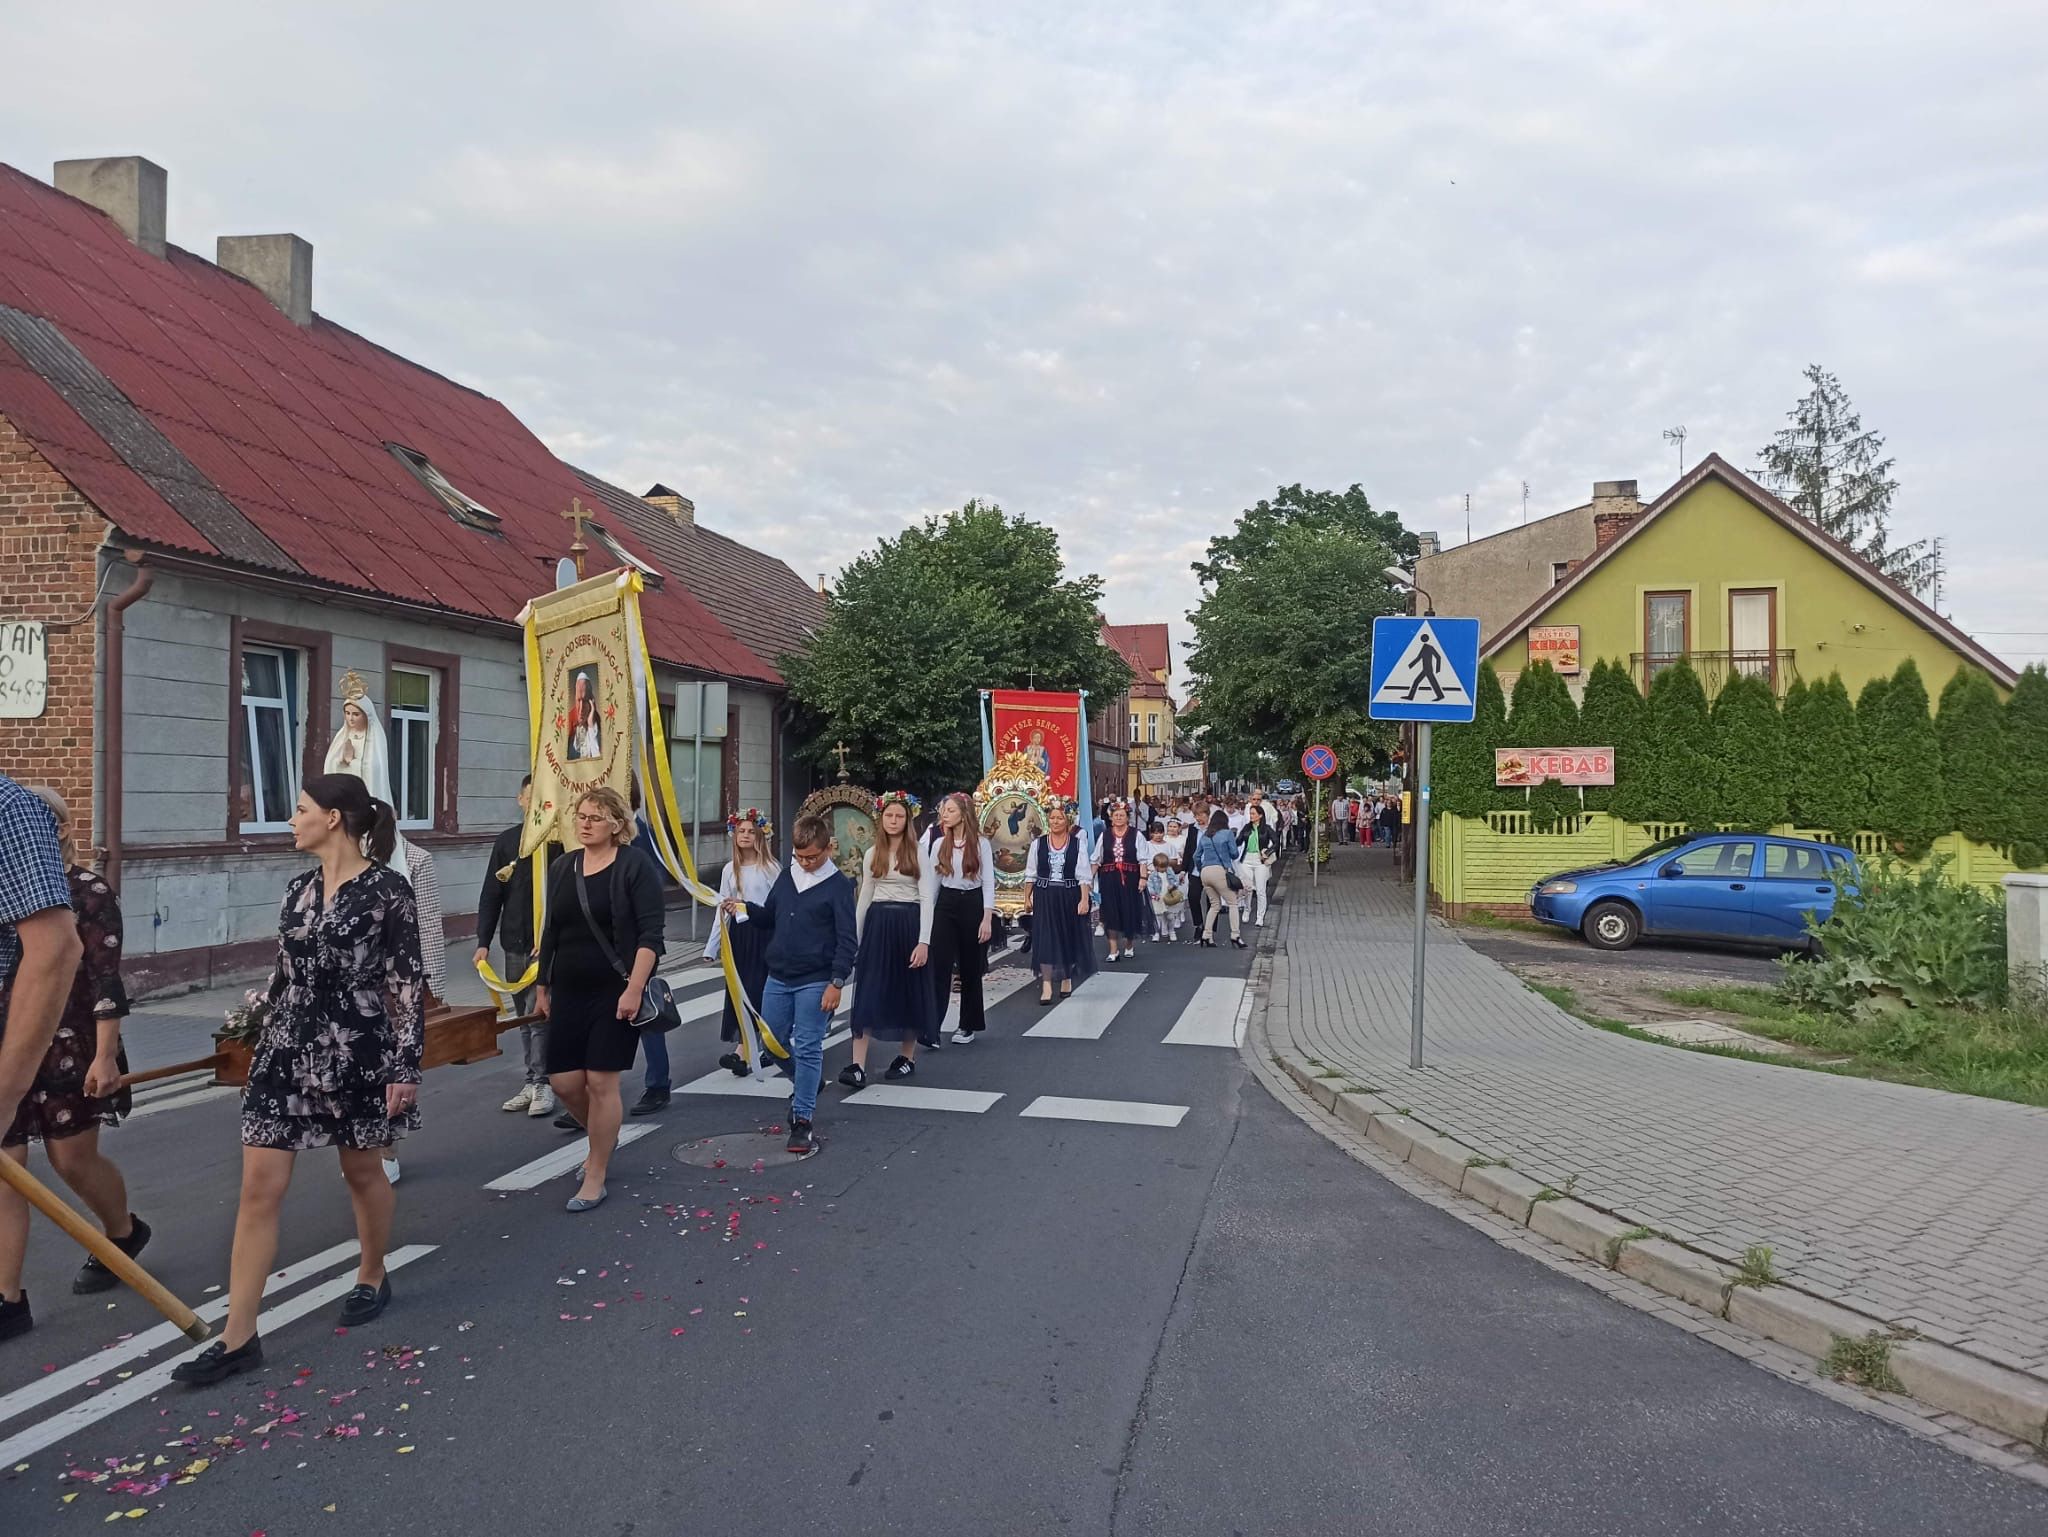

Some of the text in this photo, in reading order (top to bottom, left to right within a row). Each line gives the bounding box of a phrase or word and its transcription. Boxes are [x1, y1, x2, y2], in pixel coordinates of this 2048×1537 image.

[565, 640, 575, 658] OD
[574, 634, 592, 649] SIEBIE
[591, 635, 624, 683] WYMAGAĆ
[1529, 640, 1578, 650] KEBAB
[998, 718, 1074, 763] AJŚWIĘTSZE SERCE JEZUSA
[544, 742, 562, 778] NAWET
[1529, 755, 1609, 775] KEBAB
